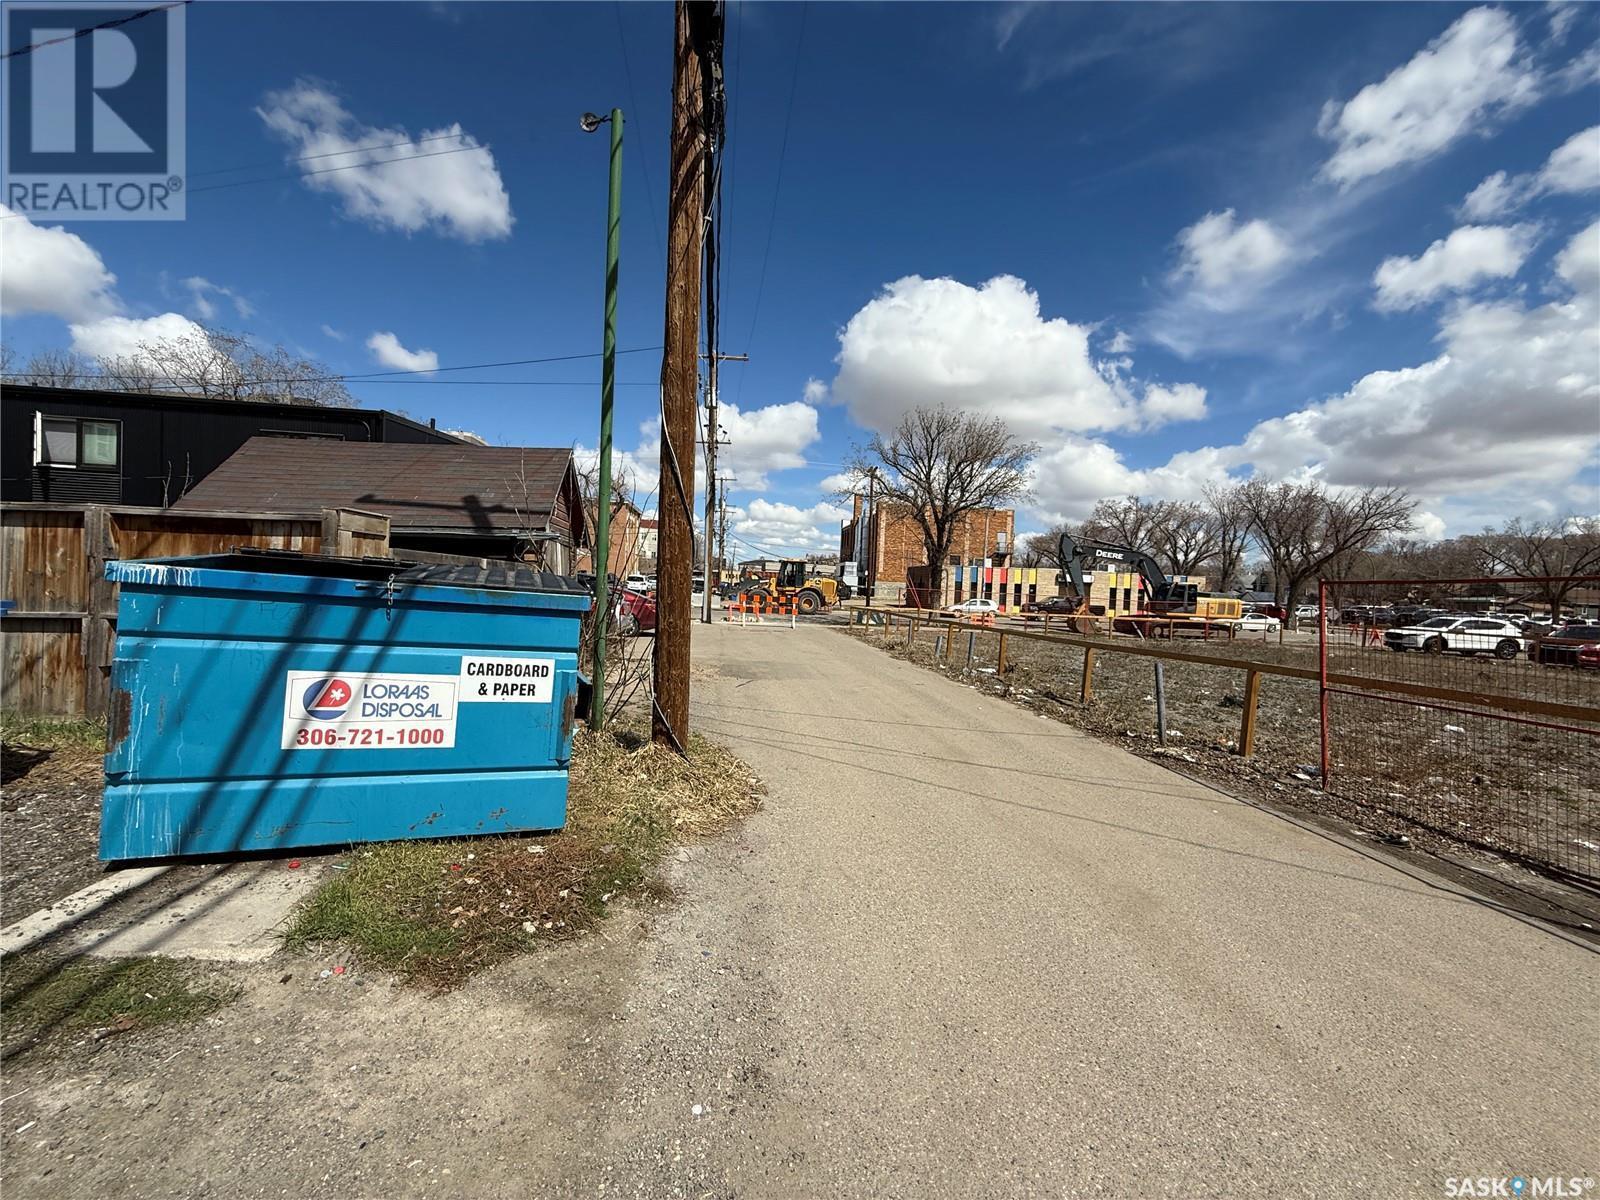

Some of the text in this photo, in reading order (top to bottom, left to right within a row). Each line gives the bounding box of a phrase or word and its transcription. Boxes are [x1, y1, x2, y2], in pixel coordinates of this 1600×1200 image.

[1095, 549, 1124, 560] DEERE
[466, 662, 549, 678] CARDBOARD
[363, 684, 430, 700] LORAAS
[478, 682, 536, 696] & PAPER
[361, 702, 443, 718] DISPOSAL
[296, 728, 444, 746] 306-721-1000
